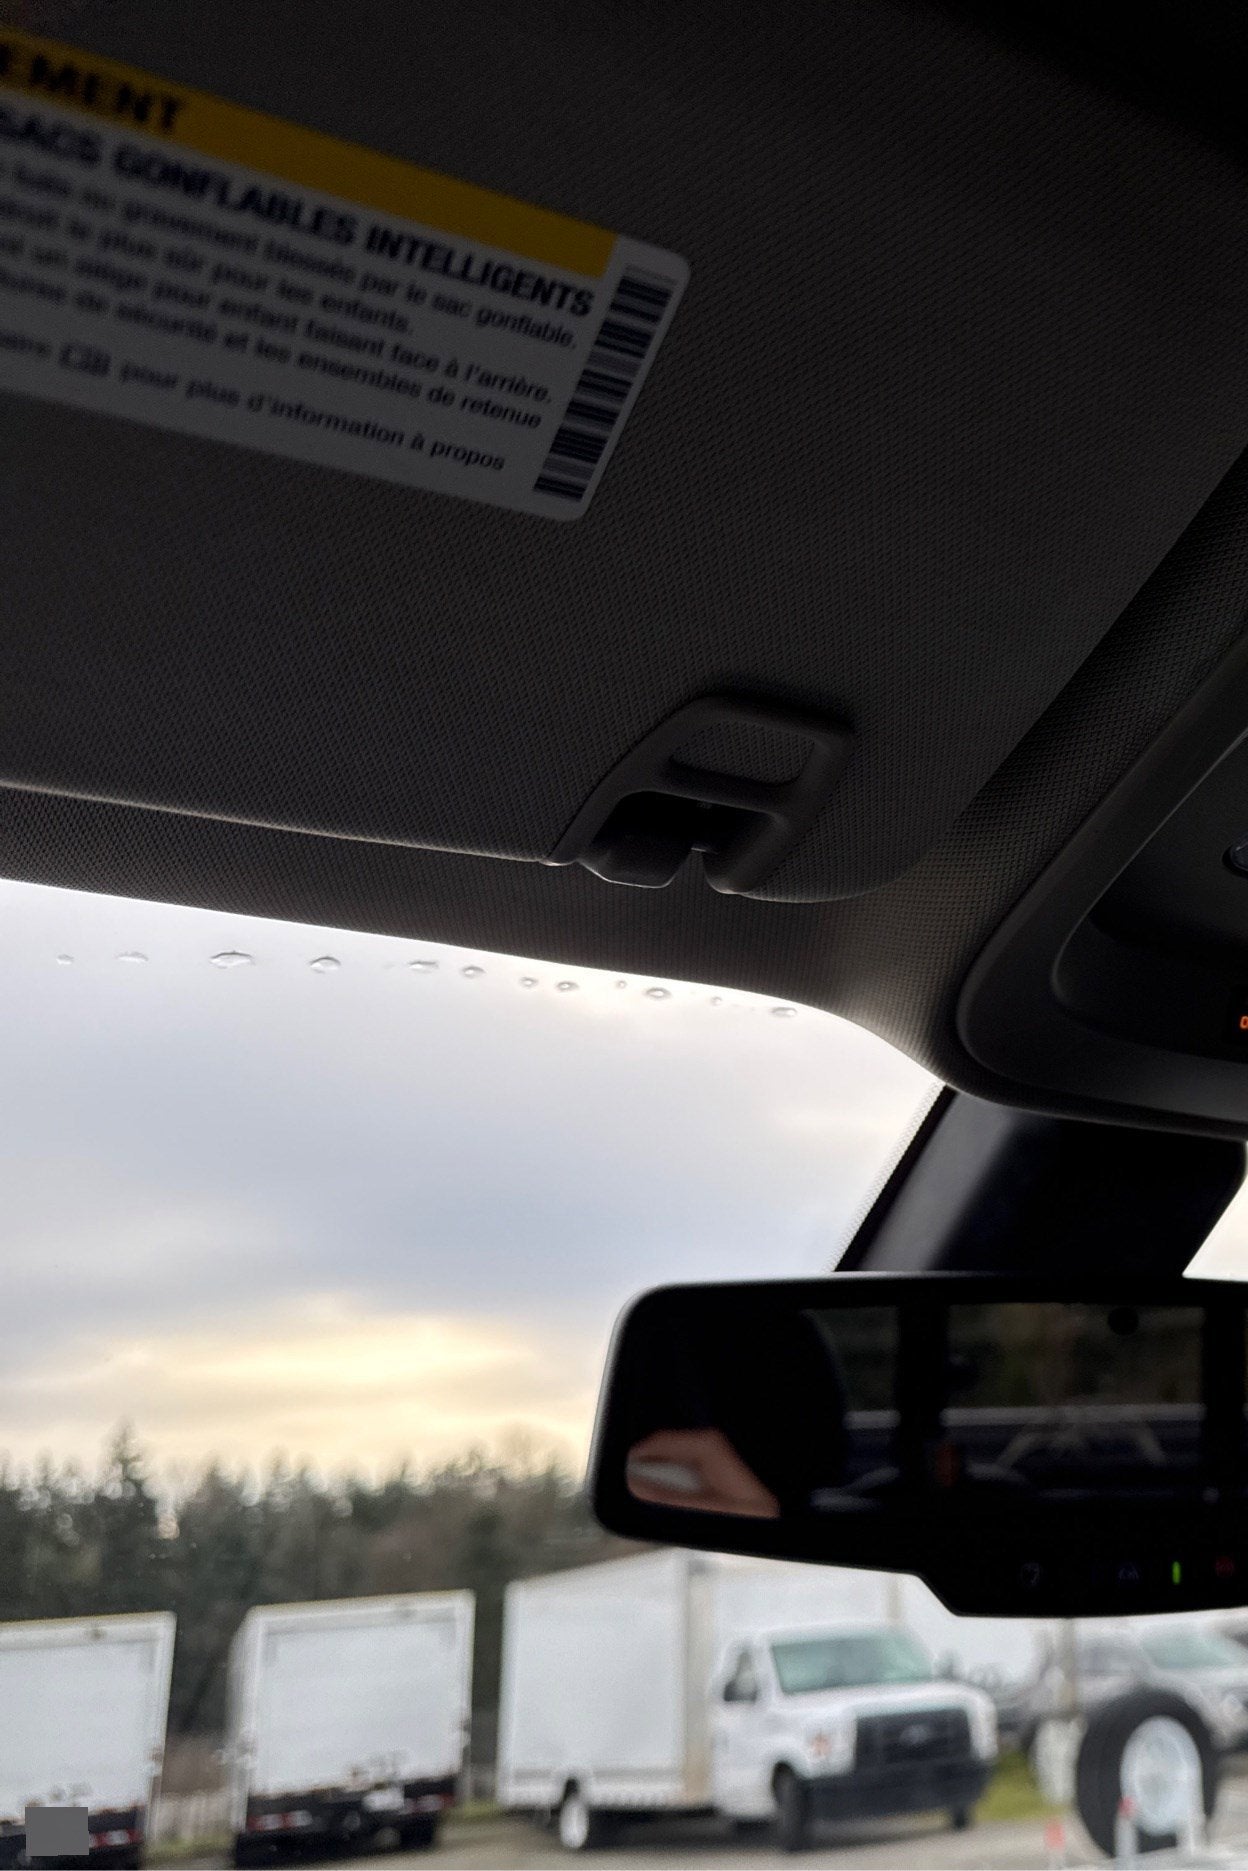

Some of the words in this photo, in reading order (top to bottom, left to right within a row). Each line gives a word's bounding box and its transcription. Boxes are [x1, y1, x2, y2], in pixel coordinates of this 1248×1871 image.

[0, 43, 185, 134] EMENT
[0, 104, 102, 168] SACS
[113, 143, 357, 247] GONFLABLES
[365, 223, 594, 318] INTELLIGENTS
[124, 202, 259, 256] gravement
[263, 239, 356, 285] blessés
[360, 272, 400, 299] par
[404, 283, 428, 306] le
[432, 292, 473, 318] sac
[153, 280, 211, 311] pour
[217, 299, 299, 336] enfant
[304, 318, 385, 359] faisant
[389, 342, 440, 373] face
[444, 356, 459, 379] à
[211, 262, 269, 293] pour
[277, 277, 314, 305] les
[117, 303, 218, 345] sécurité
[224, 332, 249, 355] et
[255, 338, 291, 365] les
[298, 352, 422, 399] ensembles
[427, 386, 456, 408] de
[460, 396, 543, 430] retenue
[120, 362, 179, 391] pour
[186, 379, 241, 409] plus
[247, 393, 405, 447] d'information
[411, 433, 426, 452] à
[430, 441, 506, 472] propos
